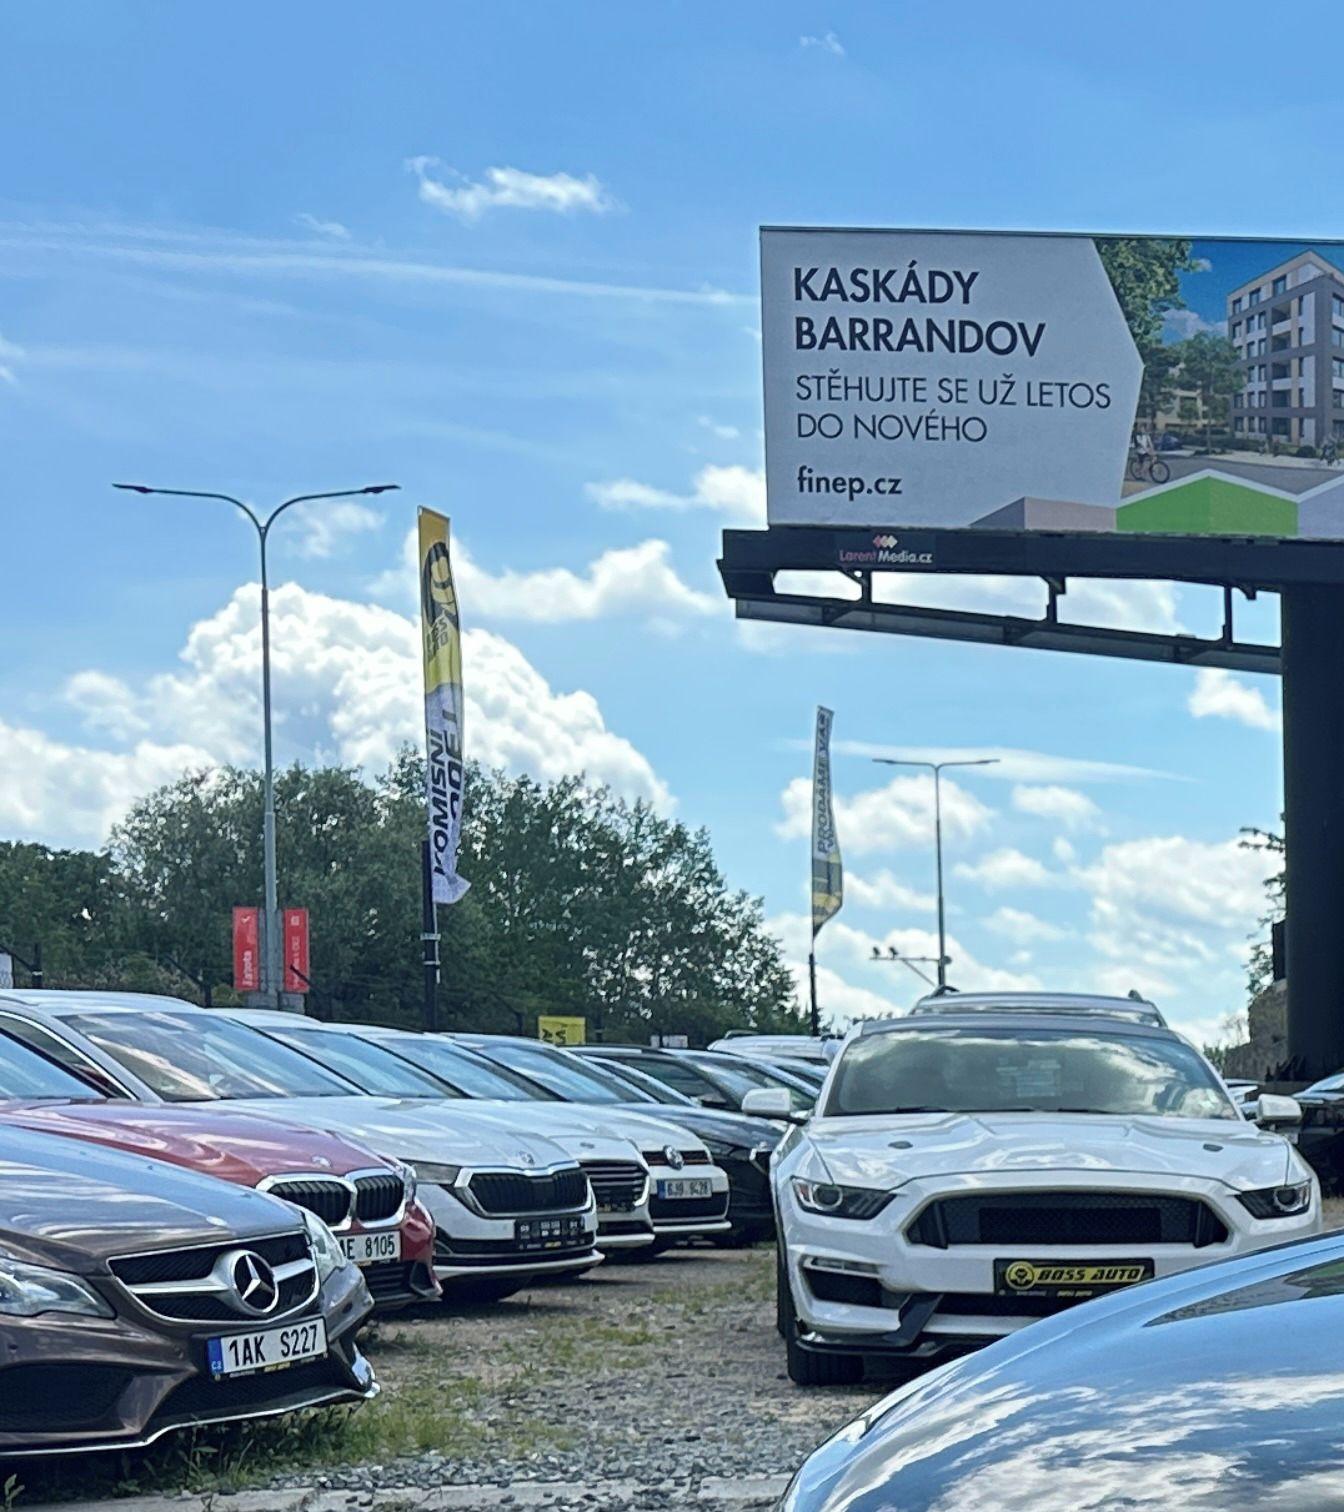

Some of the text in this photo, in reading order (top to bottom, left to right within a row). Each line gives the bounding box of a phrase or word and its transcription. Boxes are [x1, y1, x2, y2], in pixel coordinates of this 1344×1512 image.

[794, 260, 979, 304] KASKÁDY
[795, 316, 1046, 357] BARRANDOV
[796, 368, 1112, 409] STĚHUJTE SE UŽ LETOS
[797, 408, 988, 442] DO NOVÉHO
[797, 465, 903, 501] finep.cz
[365, 1234, 395, 1258] 8105
[1037, 1268, 1141, 1281] BOSS AUTO
[229, 1334, 266, 1367] 1AK
[280, 1324, 317, 1358] S227
